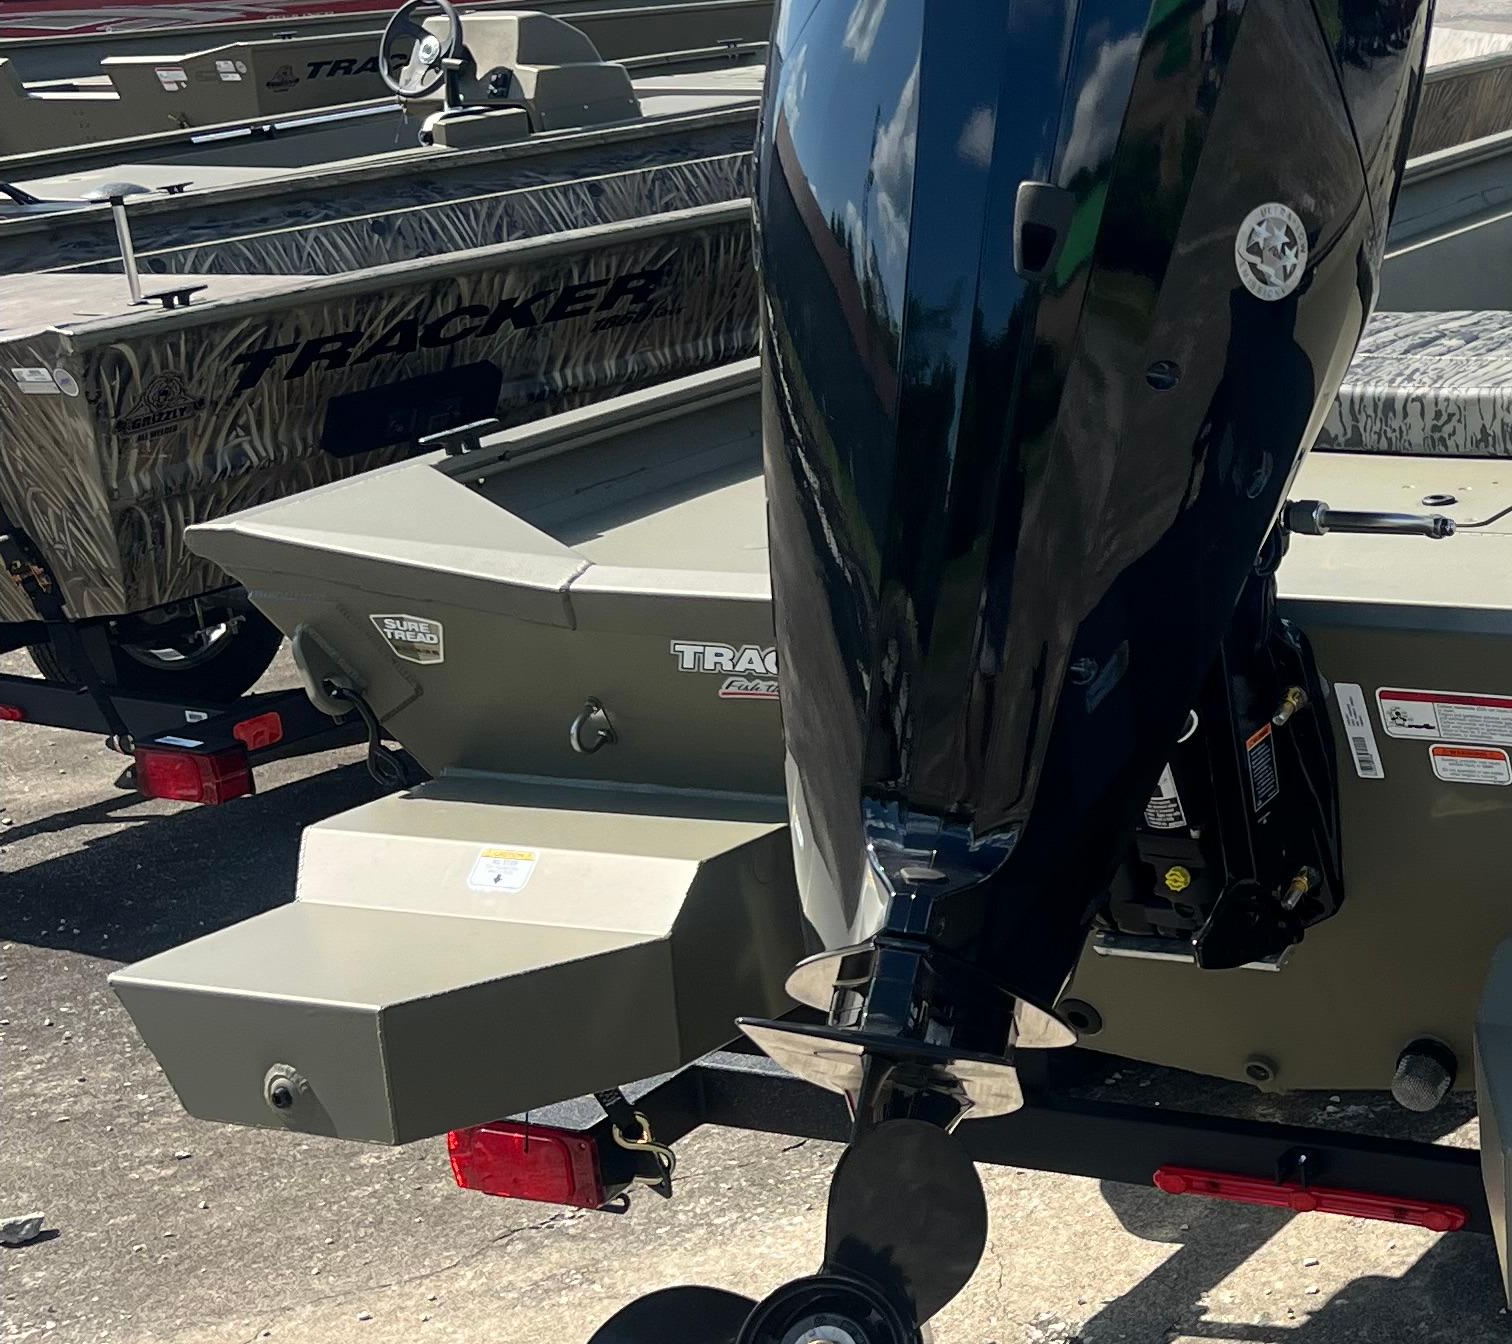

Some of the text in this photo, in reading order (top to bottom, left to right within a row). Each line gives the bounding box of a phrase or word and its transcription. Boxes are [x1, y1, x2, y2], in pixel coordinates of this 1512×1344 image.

[229, 268, 664, 399] TRACKER
[131, 406, 188, 430] GRIZZLY
[383, 618, 430, 633] SURE
[383, 628, 439, 644] TREAD
